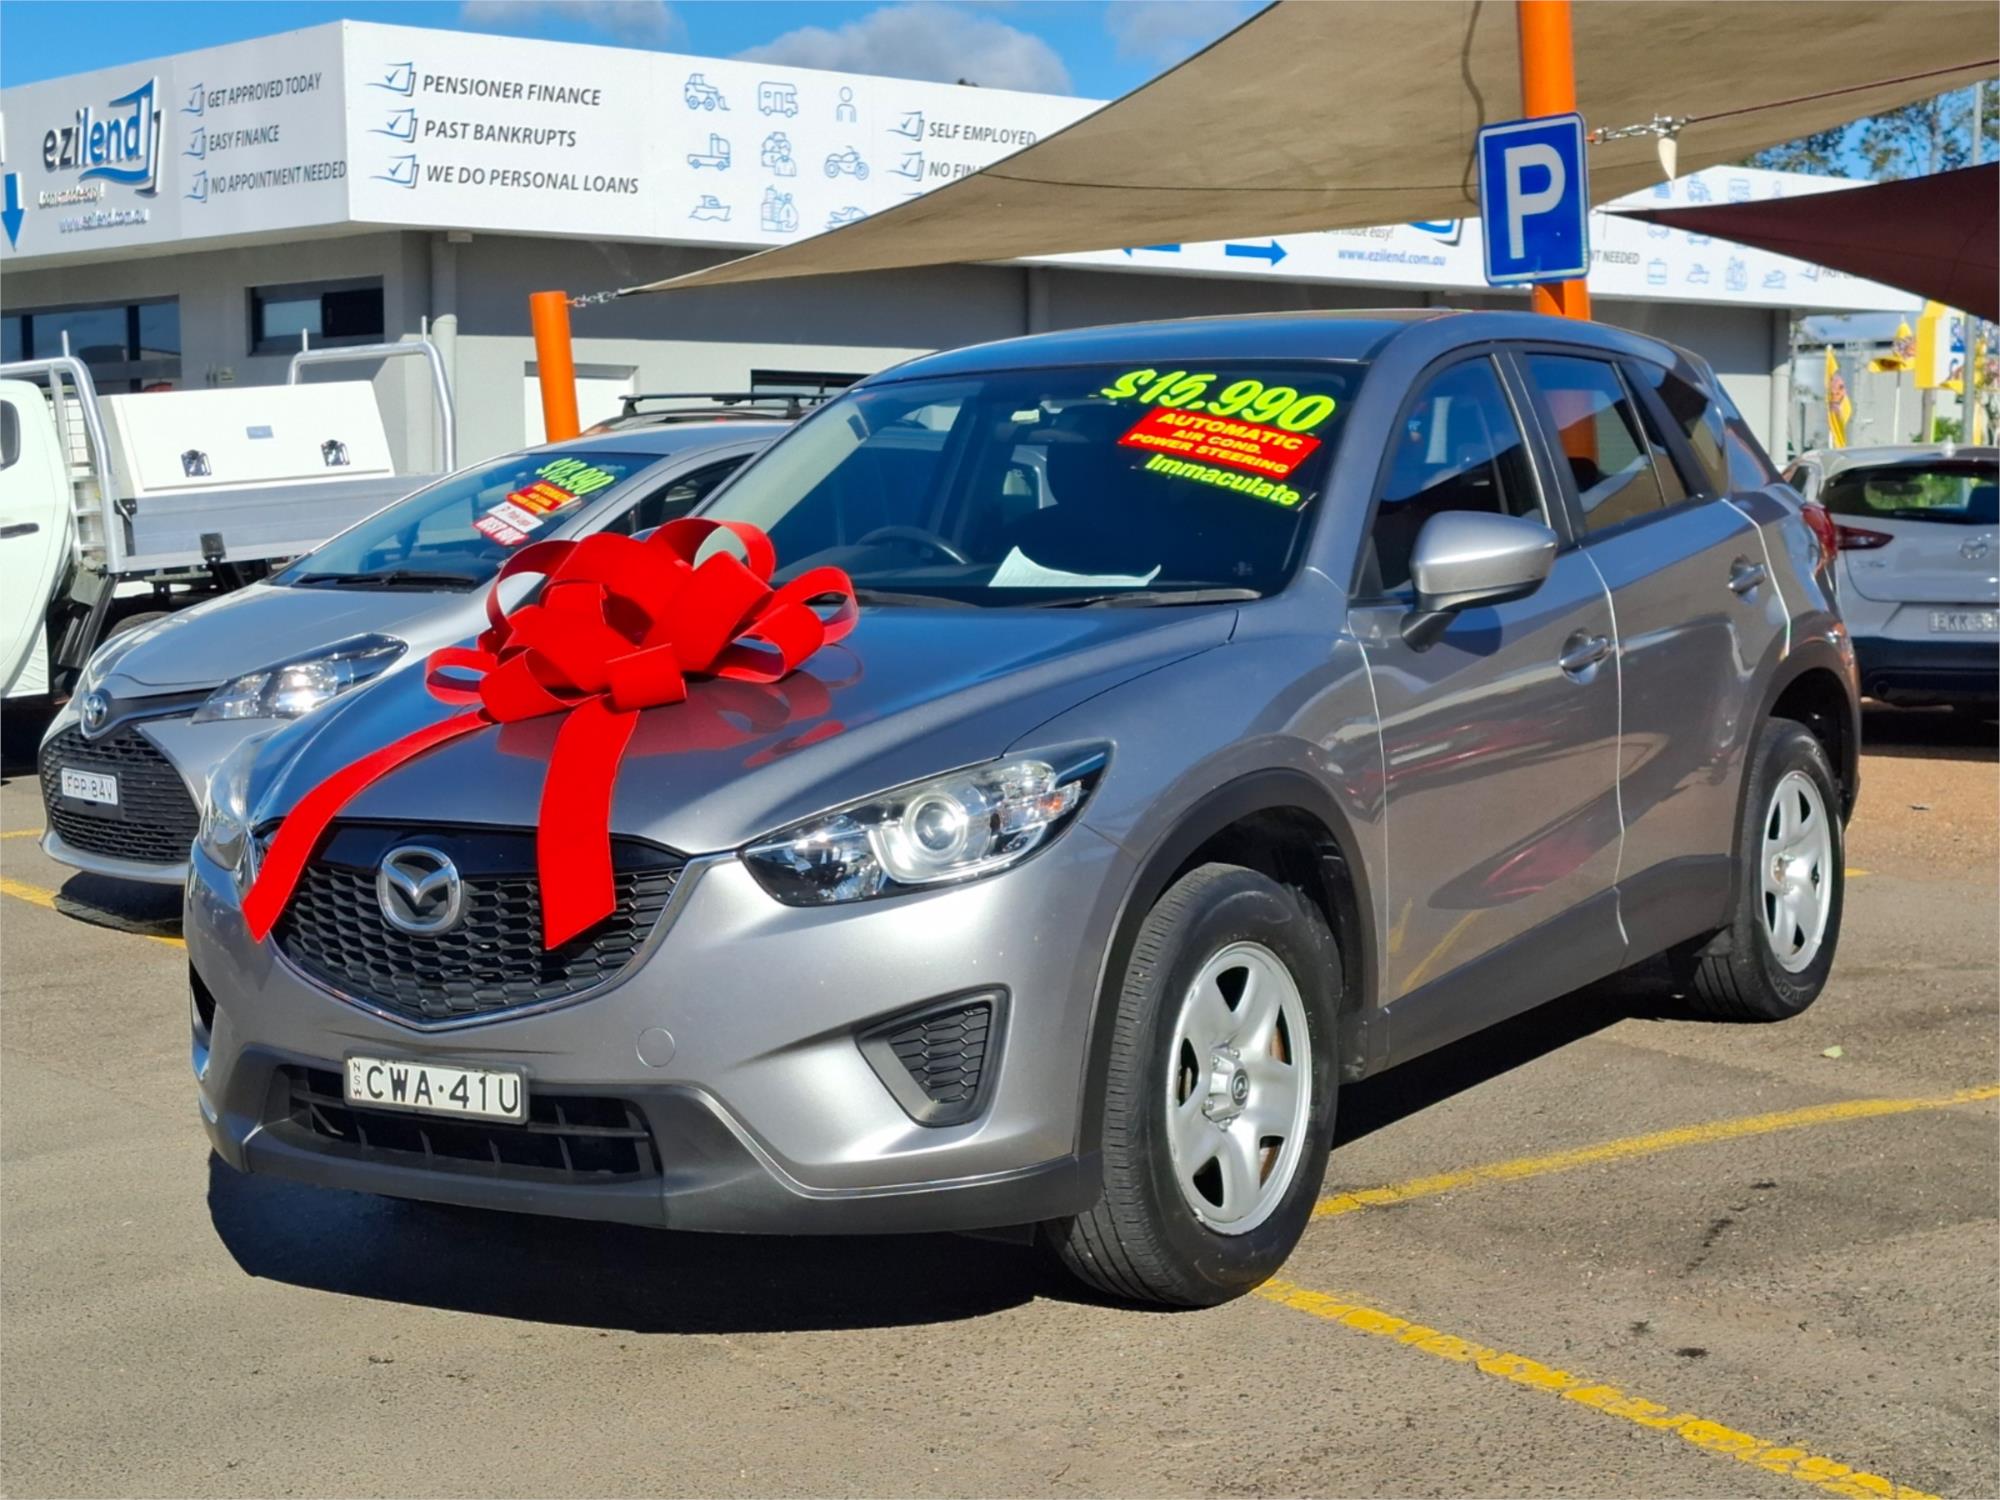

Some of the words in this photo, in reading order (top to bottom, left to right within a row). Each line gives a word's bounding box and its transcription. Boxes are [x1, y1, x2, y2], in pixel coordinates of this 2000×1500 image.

[208, 88, 228, 108] GET
[229, 79, 284, 105] APPROVED
[285, 72, 322, 95] TODAY
[423, 74, 523, 100] PENSIONER
[527, 84, 601, 106] FINANCE
[43, 97, 146, 169] ezilend
[209, 130, 234, 151] EASY
[235, 125, 280, 147] FINANCE
[425, 120, 470, 139] PAST
[474, 124, 577, 148] BANKRUPTS
[928, 122, 961, 139] SELF
[963, 125, 1037, 147] EMPLOYED
[211, 176, 226, 194] NO
[227, 166, 302, 192] APPOINTMENT
[303, 160, 347, 182] NEEDED
[426, 165, 454, 183] WE
[458, 167, 486, 186] DO
[489, 169, 580, 191] PERSONAL
[583, 175, 639, 194] LOANS
[928, 161, 951, 177] NO
[1504, 143, 1566, 260] P
[1338, 249, 1446, 266] www.ezilend.com.au
[1603, 250, 1640, 265] NEEDED
[1156, 413, 1304, 450] AUTOMATIC
[1172, 430, 1205, 442] AIR
[1208, 436, 1262, 454] COND.
[1129, 433, 1194, 451] POWER
[1195, 445, 1289, 474] STEERING
[1145, 453, 1300, 506] Immaculate
